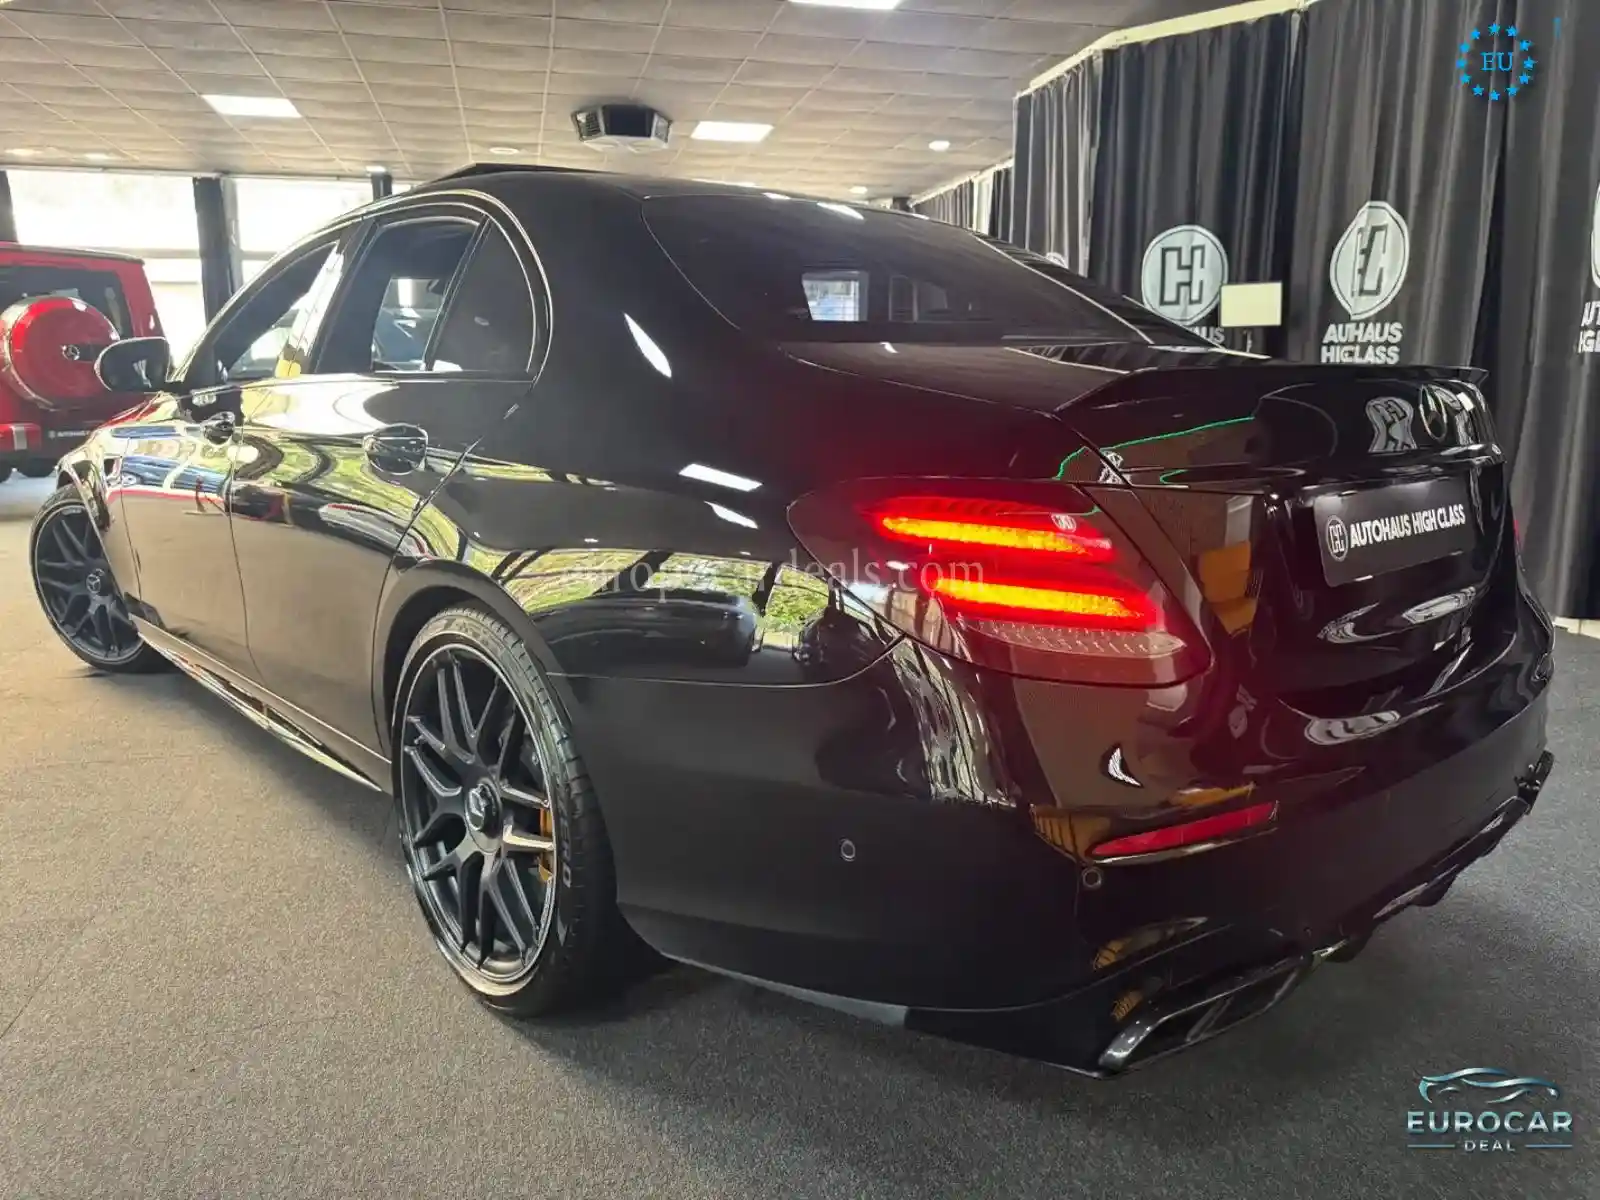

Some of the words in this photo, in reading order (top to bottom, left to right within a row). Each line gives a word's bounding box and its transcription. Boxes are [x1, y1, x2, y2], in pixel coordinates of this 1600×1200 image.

[1350, 514, 1413, 548] AUTOHAUS
[1411, 509, 1438, 534] HIGH
[1437, 503, 1466, 528] CLASS
